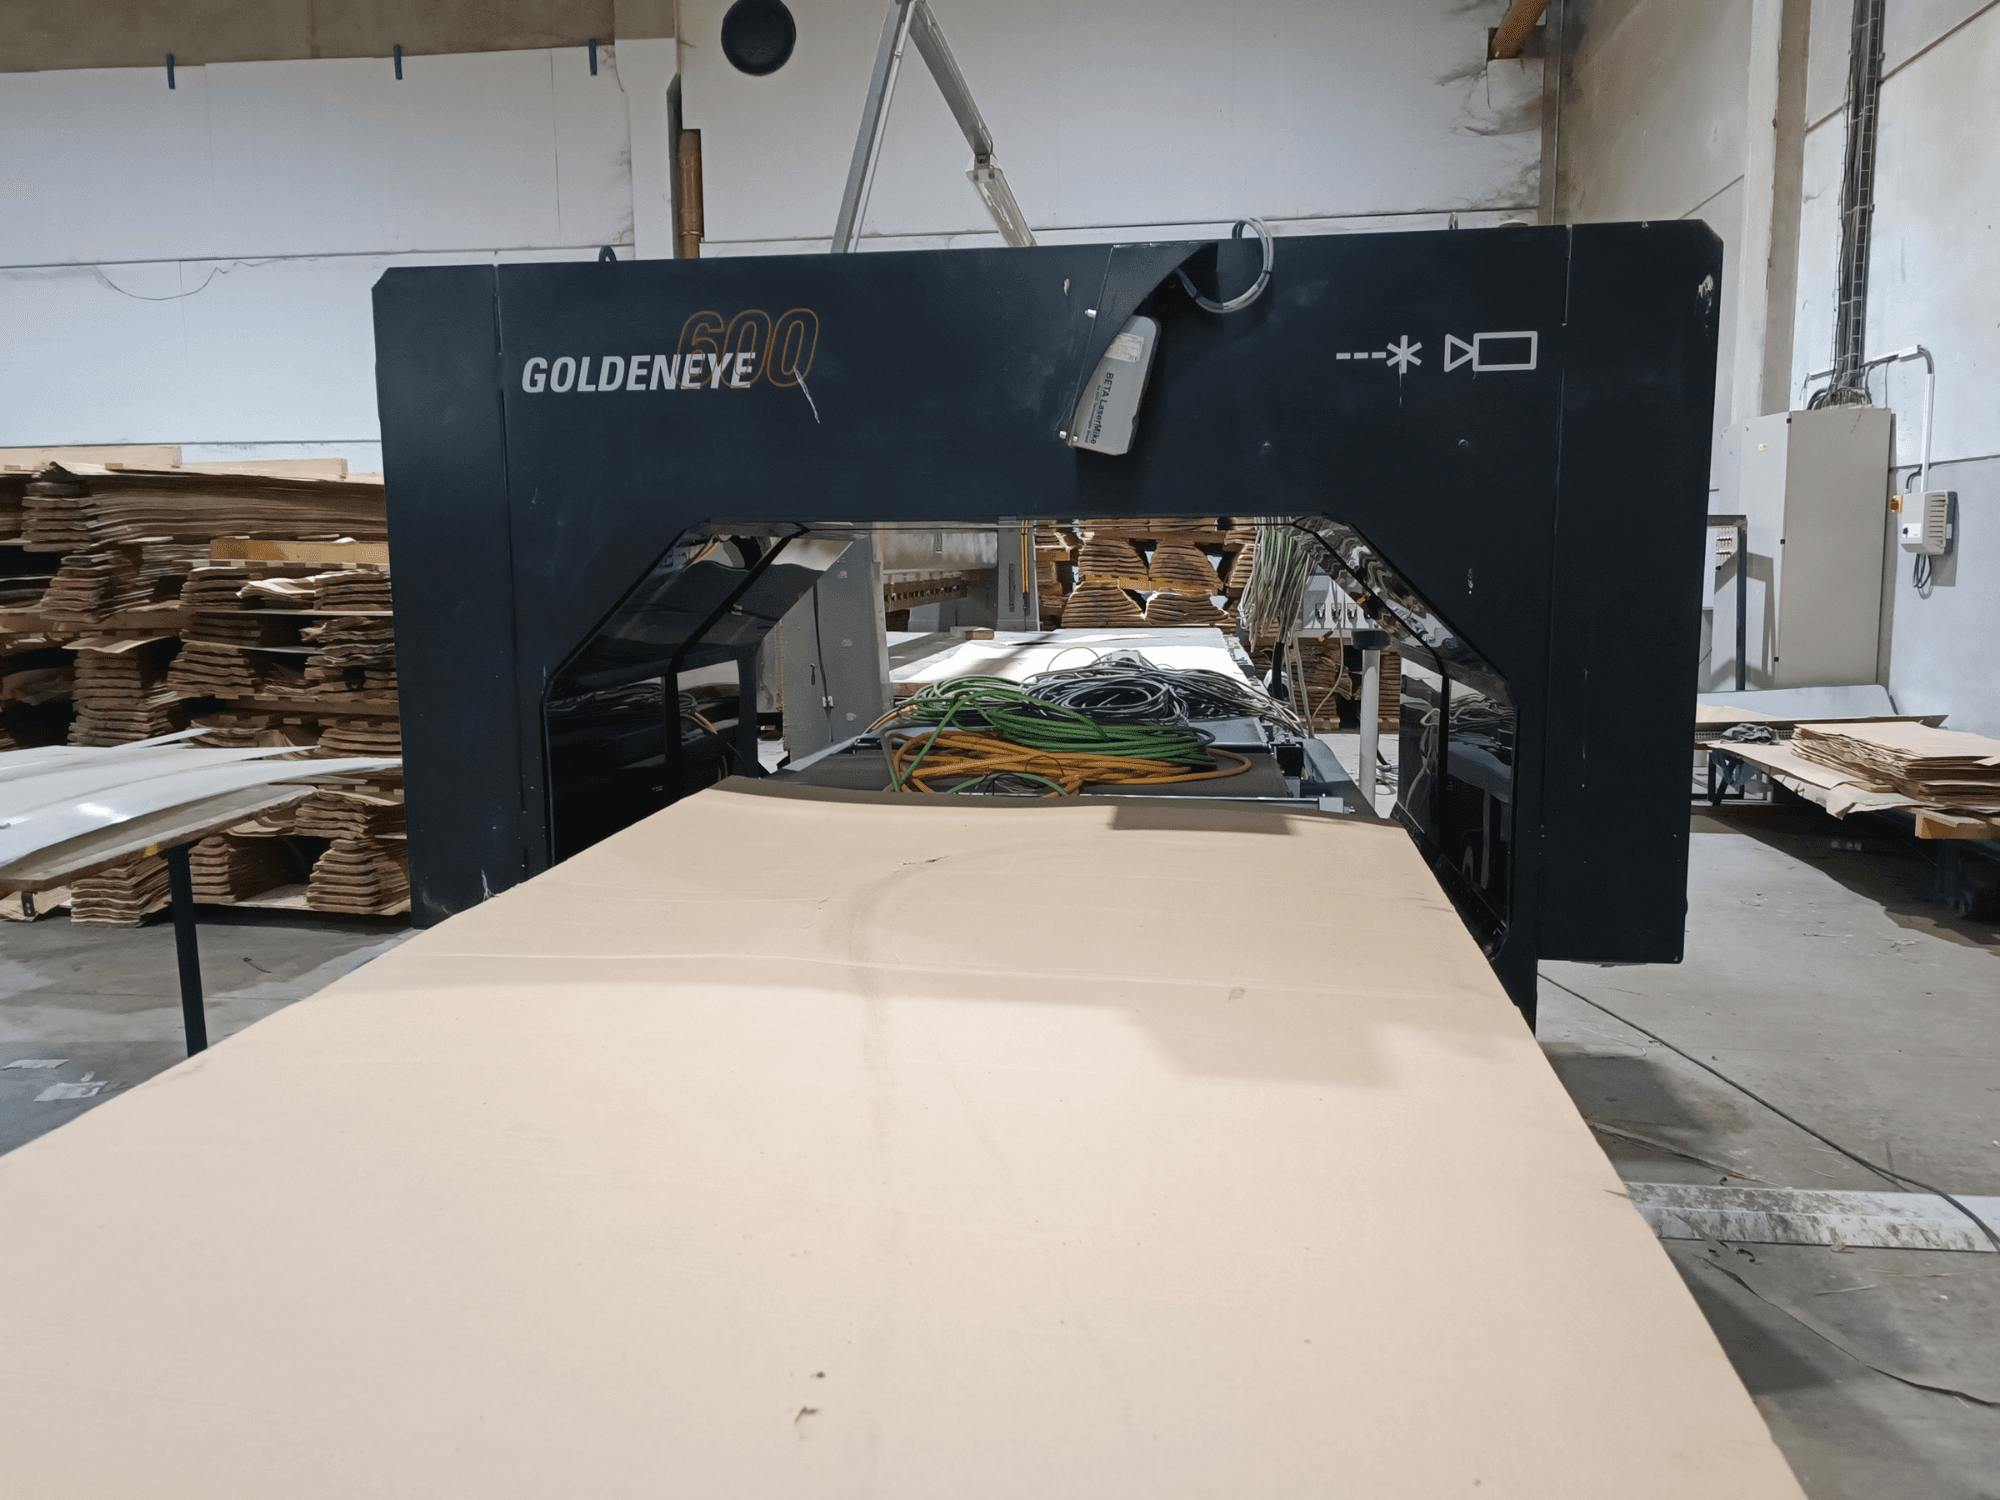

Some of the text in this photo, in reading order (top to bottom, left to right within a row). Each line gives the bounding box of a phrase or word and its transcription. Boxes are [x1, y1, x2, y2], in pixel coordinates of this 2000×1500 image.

[522, 308, 819, 393] GOLDENEYE 600
[1102, 372, 1114, 397] BETA
